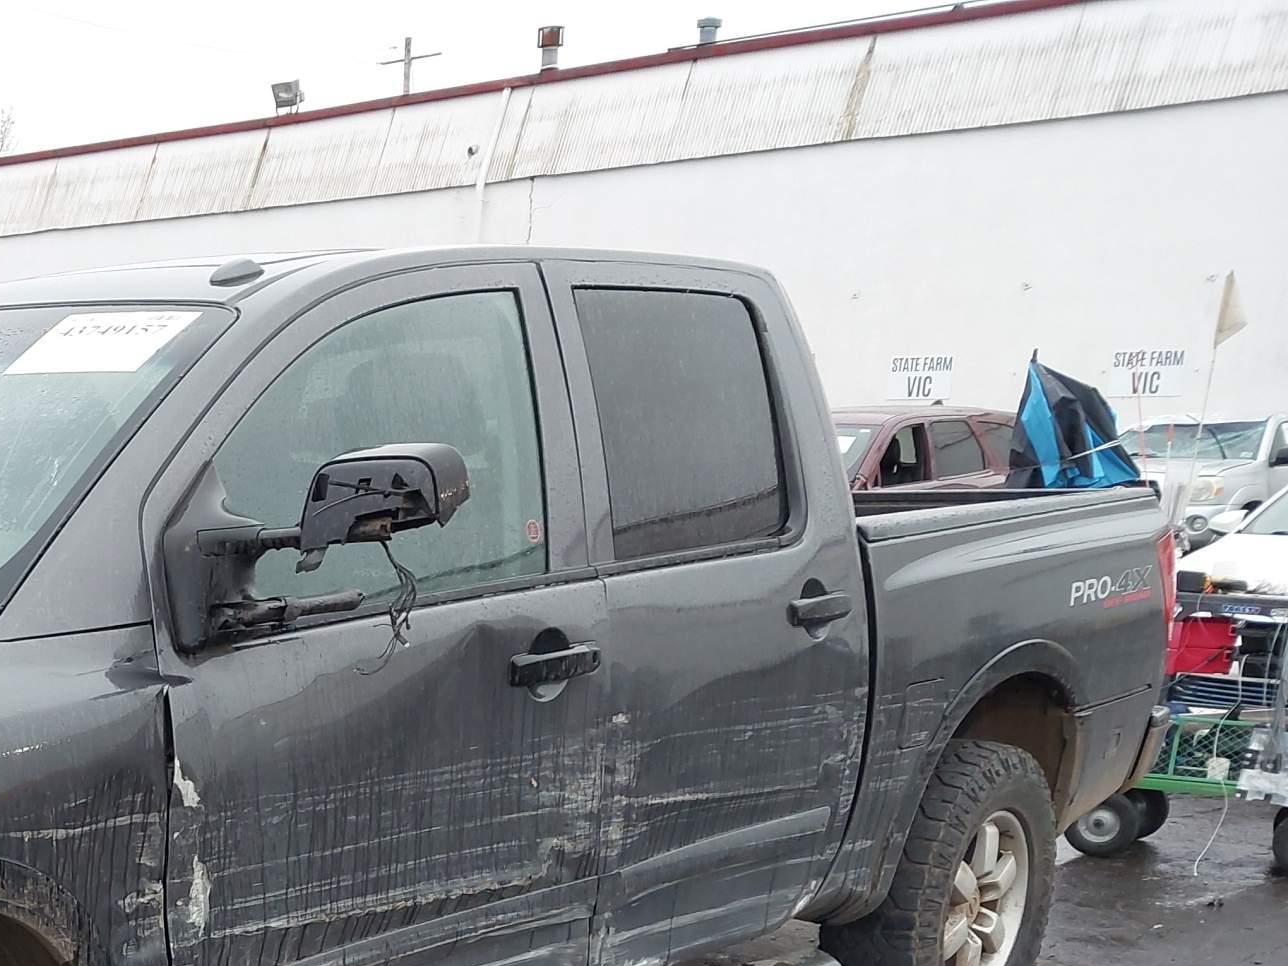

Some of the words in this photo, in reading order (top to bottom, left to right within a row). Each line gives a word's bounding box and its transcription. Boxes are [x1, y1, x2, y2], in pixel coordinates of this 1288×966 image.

[891, 357, 921, 373] STATE
[922, 356, 953, 372] FARM
[1113, 350, 1147, 368] STATE
[1149, 350, 1185, 367] FARM
[907, 375, 933, 398] VIC
[1132, 371, 1160, 395] VIC
